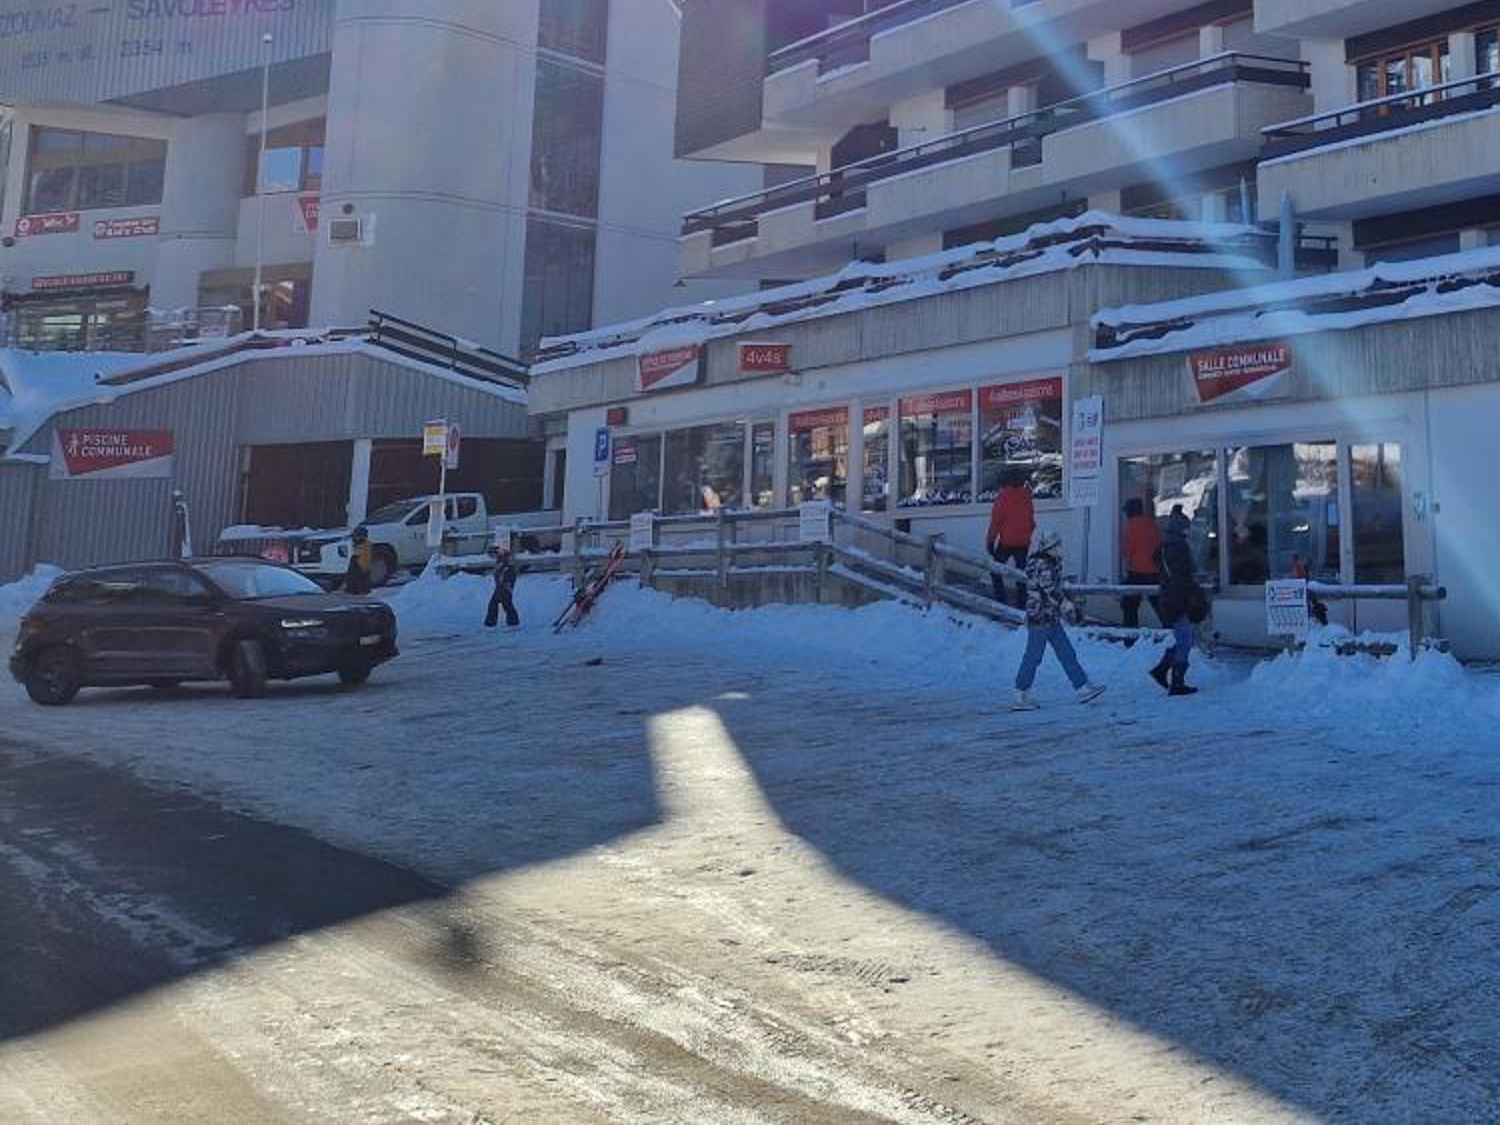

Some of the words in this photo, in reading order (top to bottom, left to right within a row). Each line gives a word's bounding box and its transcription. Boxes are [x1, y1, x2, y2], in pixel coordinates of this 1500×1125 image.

[1198, 356, 1225, 372] SALLE
[82, 433, 129, 446] PISCINE
[81, 445, 153, 457] COMMUNALE
